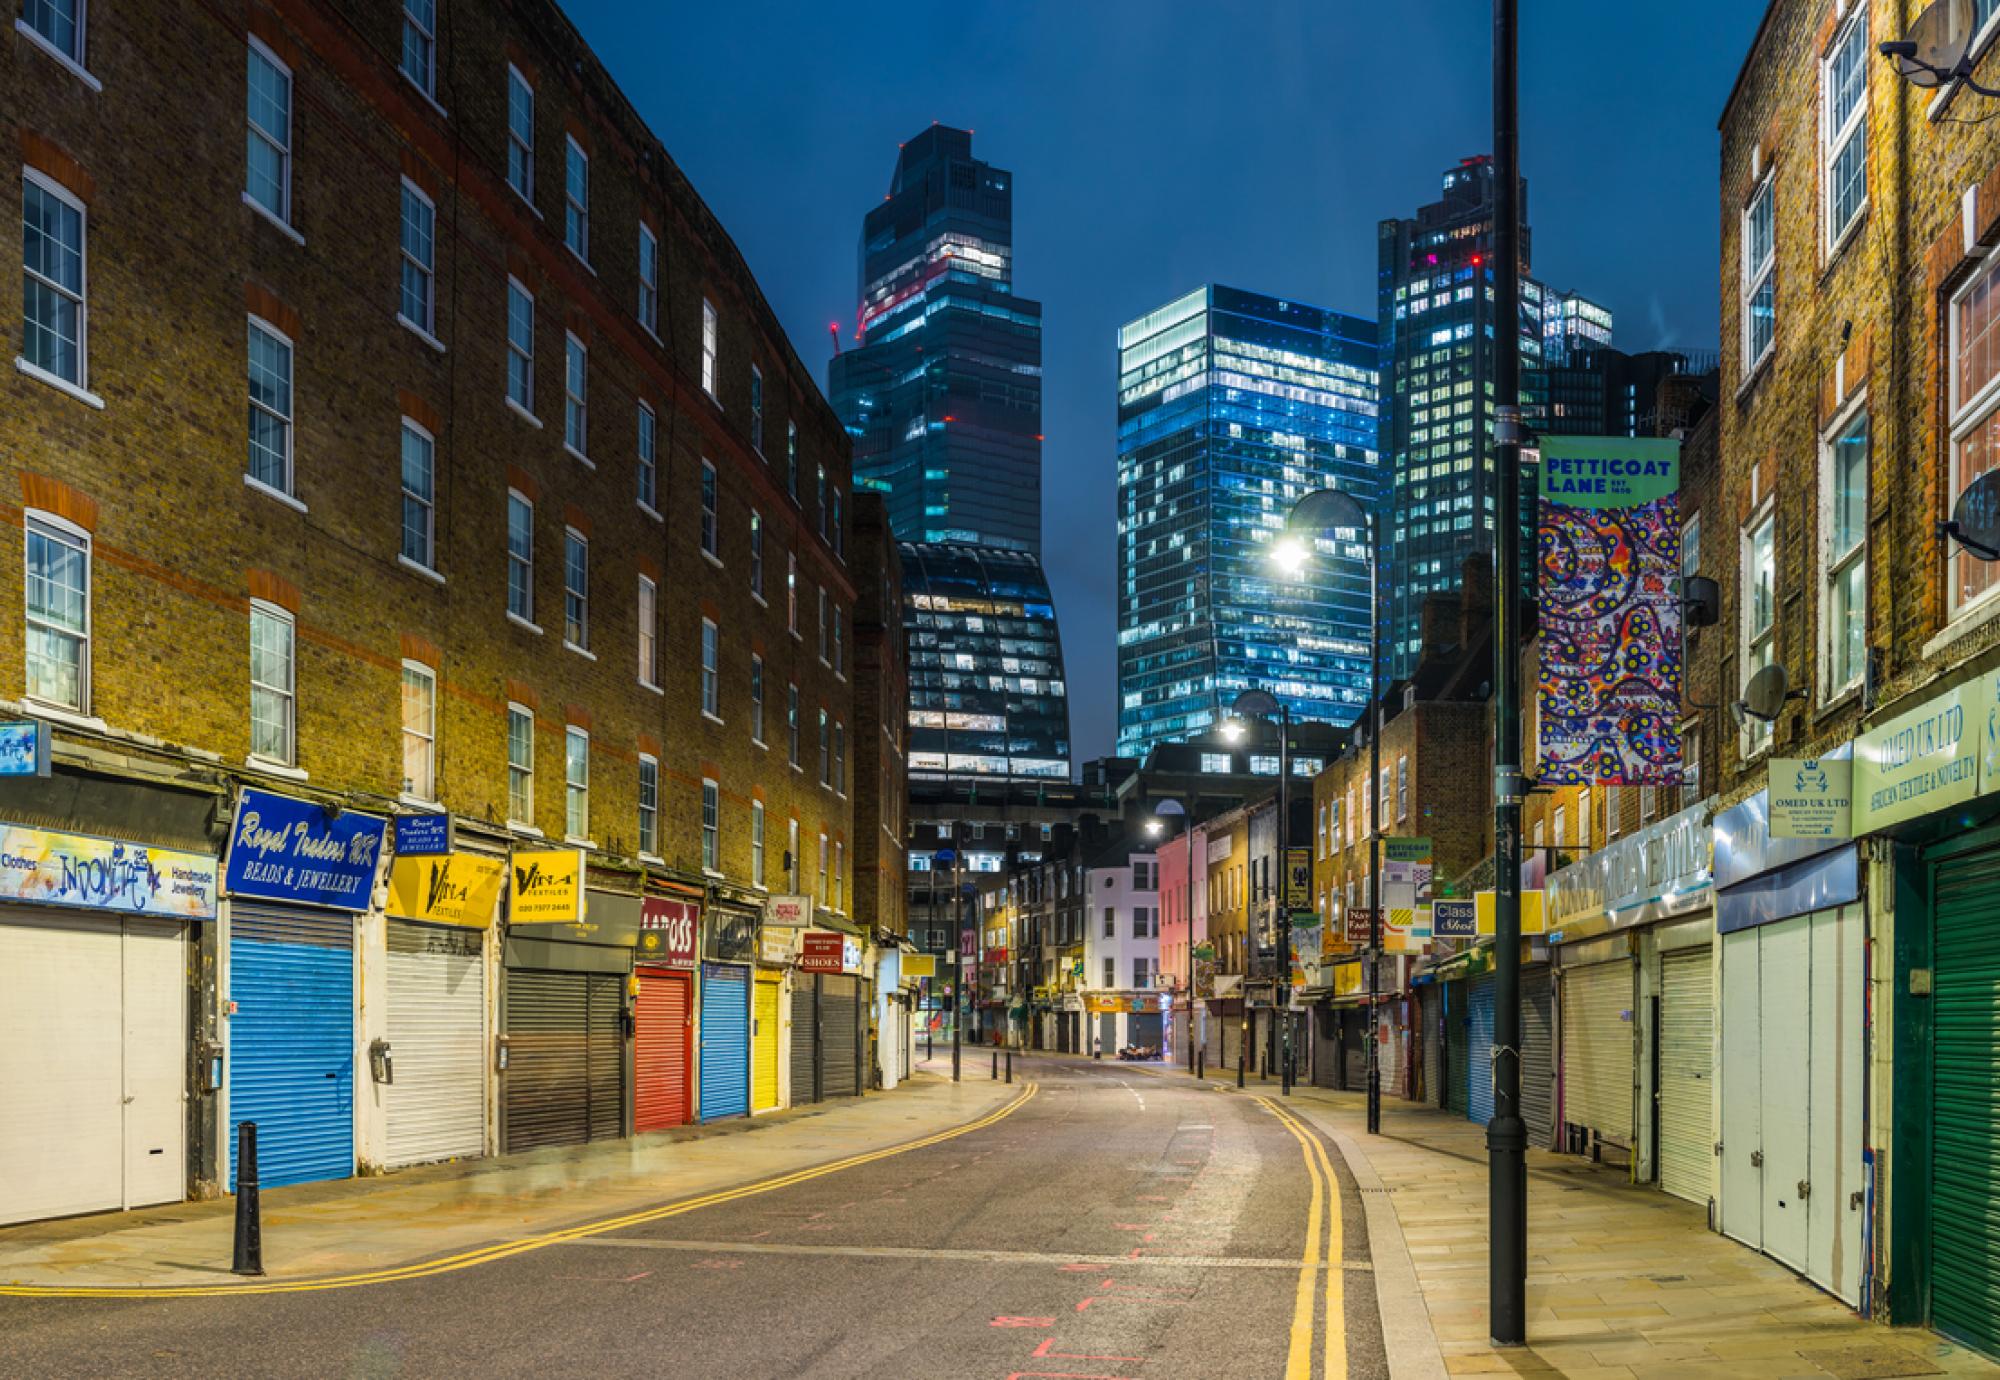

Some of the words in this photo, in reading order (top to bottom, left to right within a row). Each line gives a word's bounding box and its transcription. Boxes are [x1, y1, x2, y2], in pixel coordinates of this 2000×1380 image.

[1547, 459, 1670, 476] PETTICOAT
[1547, 478, 1606, 493] LANE
[1880, 727, 1915, 775] OMED
[1916, 717, 1935, 758] UK
[1937, 704, 1964, 750] LTD
[1775, 799, 1809, 808] OMED
[1810, 799, 1826, 808] UK
[1827, 799, 1850, 808] LTD
[237, 812, 292, 858] Royal
[293, 821, 347, 862] Traders
[171, 865, 213, 884] Handmade
[242, 860, 284, 884] BEADS
[283, 867, 295, 886] &
[293, 869, 362, 893] JEWELLERY
[1437, 903, 1475, 918] Class
[804, 957, 840, 968] SHOES
